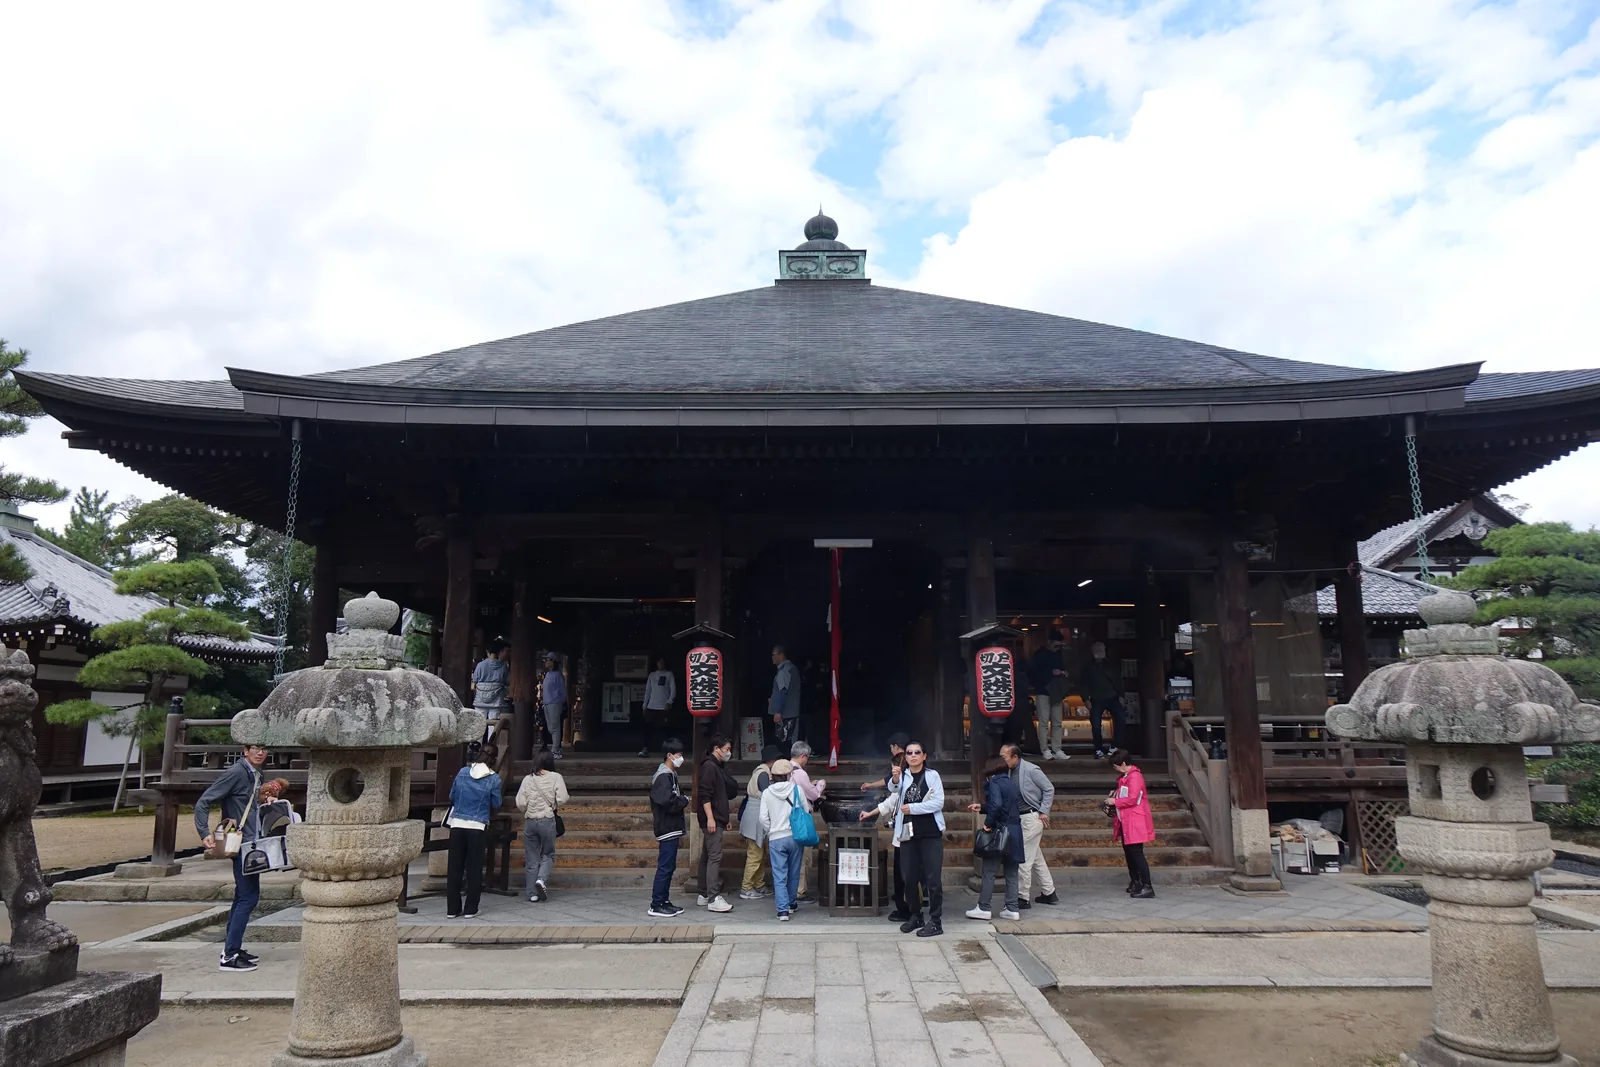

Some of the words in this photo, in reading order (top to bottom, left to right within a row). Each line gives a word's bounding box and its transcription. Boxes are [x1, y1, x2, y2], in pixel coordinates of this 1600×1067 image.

[689, 662, 720, 710] 文殊堂
[981, 662, 1013, 711] 文殊堂
